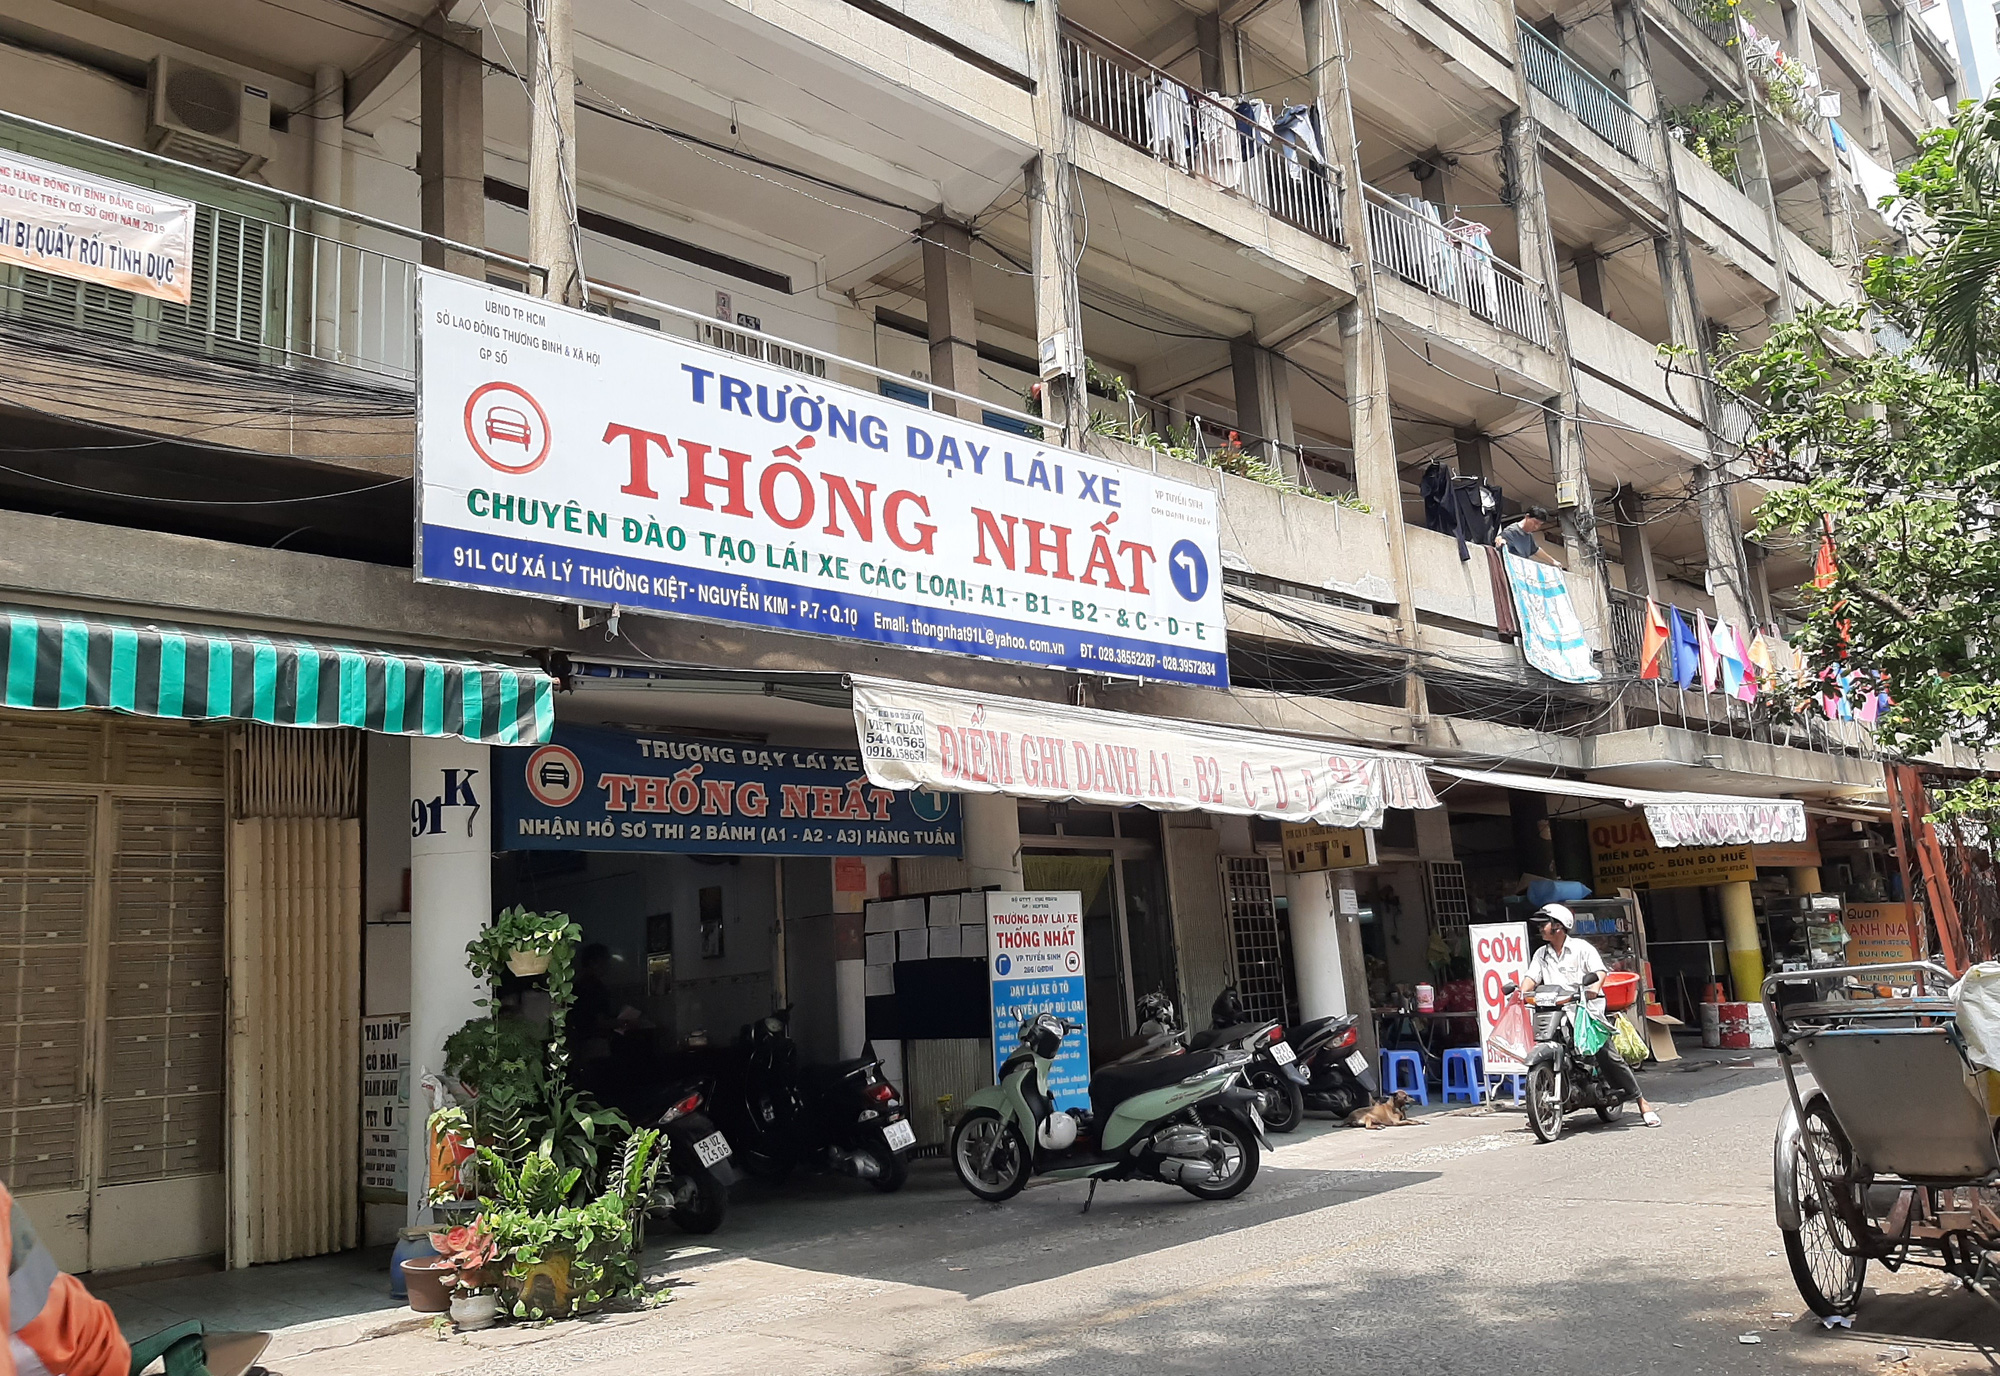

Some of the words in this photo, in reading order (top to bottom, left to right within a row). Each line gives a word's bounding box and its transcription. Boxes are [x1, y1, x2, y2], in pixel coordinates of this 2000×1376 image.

[15, 221, 31, 256] BỊ
[35, 223, 75, 260] QUẤY
[79, 231, 104, 267] RỐI
[109, 240, 141, 275] TÌNH
[147, 252, 175, 286] DỤC
[485, 300, 511, 317] UBND
[526, 312, 546, 327] HCM
[436, 309, 451, 325] SỞ
[452, 317, 472, 331] LAO
[502, 328, 540, 349] THƯƠNG
[541, 338, 563, 355] BINH
[564, 346, 571, 357] &
[479, 347, 493, 360] GP
[681, 362, 888, 453] TRƯỜNG
[906, 426, 990, 479] DẠY
[1004, 451, 1065, 496] LÁI
[1077, 470, 1123, 509] XE
[602, 421, 938, 556] THỐNG
[970, 506, 1157, 597] NHẤT
[467, 488, 607, 538] CHUYÊN
[622, 514, 686, 551] ĐÀO
[699, 531, 756, 567] TẠO
[766, 541, 808, 574] LÁI
[817, 553, 850, 580] XE
[859, 559, 907, 590] CÁC
[981, 584, 1006, 608] A1
[1025, 593, 1050, 616] B1
[1071, 600, 1098, 623] B2
[1116, 608, 1130, 628] &
[1135, 612, 1147, 631] C
[1168, 617, 1180, 636] D
[1196, 623, 1206, 641] E
[453, 546, 487, 570] 91L
[491, 552, 518, 575] CƯ
[521, 553, 547, 579] XÁ
[552, 558, 573, 583] LÝ
[579, 565, 649, 595] THƯỜNG
[698, 582, 759, 611] NGUYỄN
[763, 595, 788, 615] KIM
[800, 600, 819, 620] P.7
[829, 604, 858, 626] Q.10
[1162, 656, 1216, 676] 028.39572834
[742, 749, 787, 771] DẠY
[833, 755, 860, 772] XE
[936, 704, 1014, 785] ĐIỂM
[1020, 733, 1069, 790] GHI
[1072, 740, 1142, 797] DANH
[1149, 750, 1176, 799] A1
[1193, 755, 1224, 804] B2
[1241, 760, 1257, 808] C
[1271, 765, 1290, 810] D
[598, 763, 769, 818] THỐNG
[780, 775, 896, 822] NHẤT
[519, 815, 580, 840] NHẬN
[586, 814, 615, 838] HỒ
[620, 820, 647, 839] SƠ
[652, 823, 685, 840] THI
[690, 824, 701, 840] 2
[706, 822, 756, 841] BÁNH
[760, 828, 786, 845] (A1
[802, 829, 823, 842] A2
[836, 829, 862, 846] A3)
[866, 826, 910, 844] HÀNG
[913, 826, 956, 845] TUẦN
[1032, 914, 1049, 927] DẠY
[1067, 914, 1078, 923] XE
[1850, 923, 1880, 936] ANH
[996, 926, 1040, 949] THỐNG
[1043, 925, 1076, 947] NHẤT
[1477, 932, 1523, 963] CƠM
[1046, 953, 1061, 961] SINH
[1010, 986, 1025, 998] DẠY
[1027, 983, 1039, 996] LÁI
[1041, 984, 1050, 995] XE
[996, 1003, 1007, 1017] VÀ
[365, 1024, 380, 1046] TẠI
[366, 1050, 377, 1071] CÓ
[380, 1048, 398, 1070] BÁN
